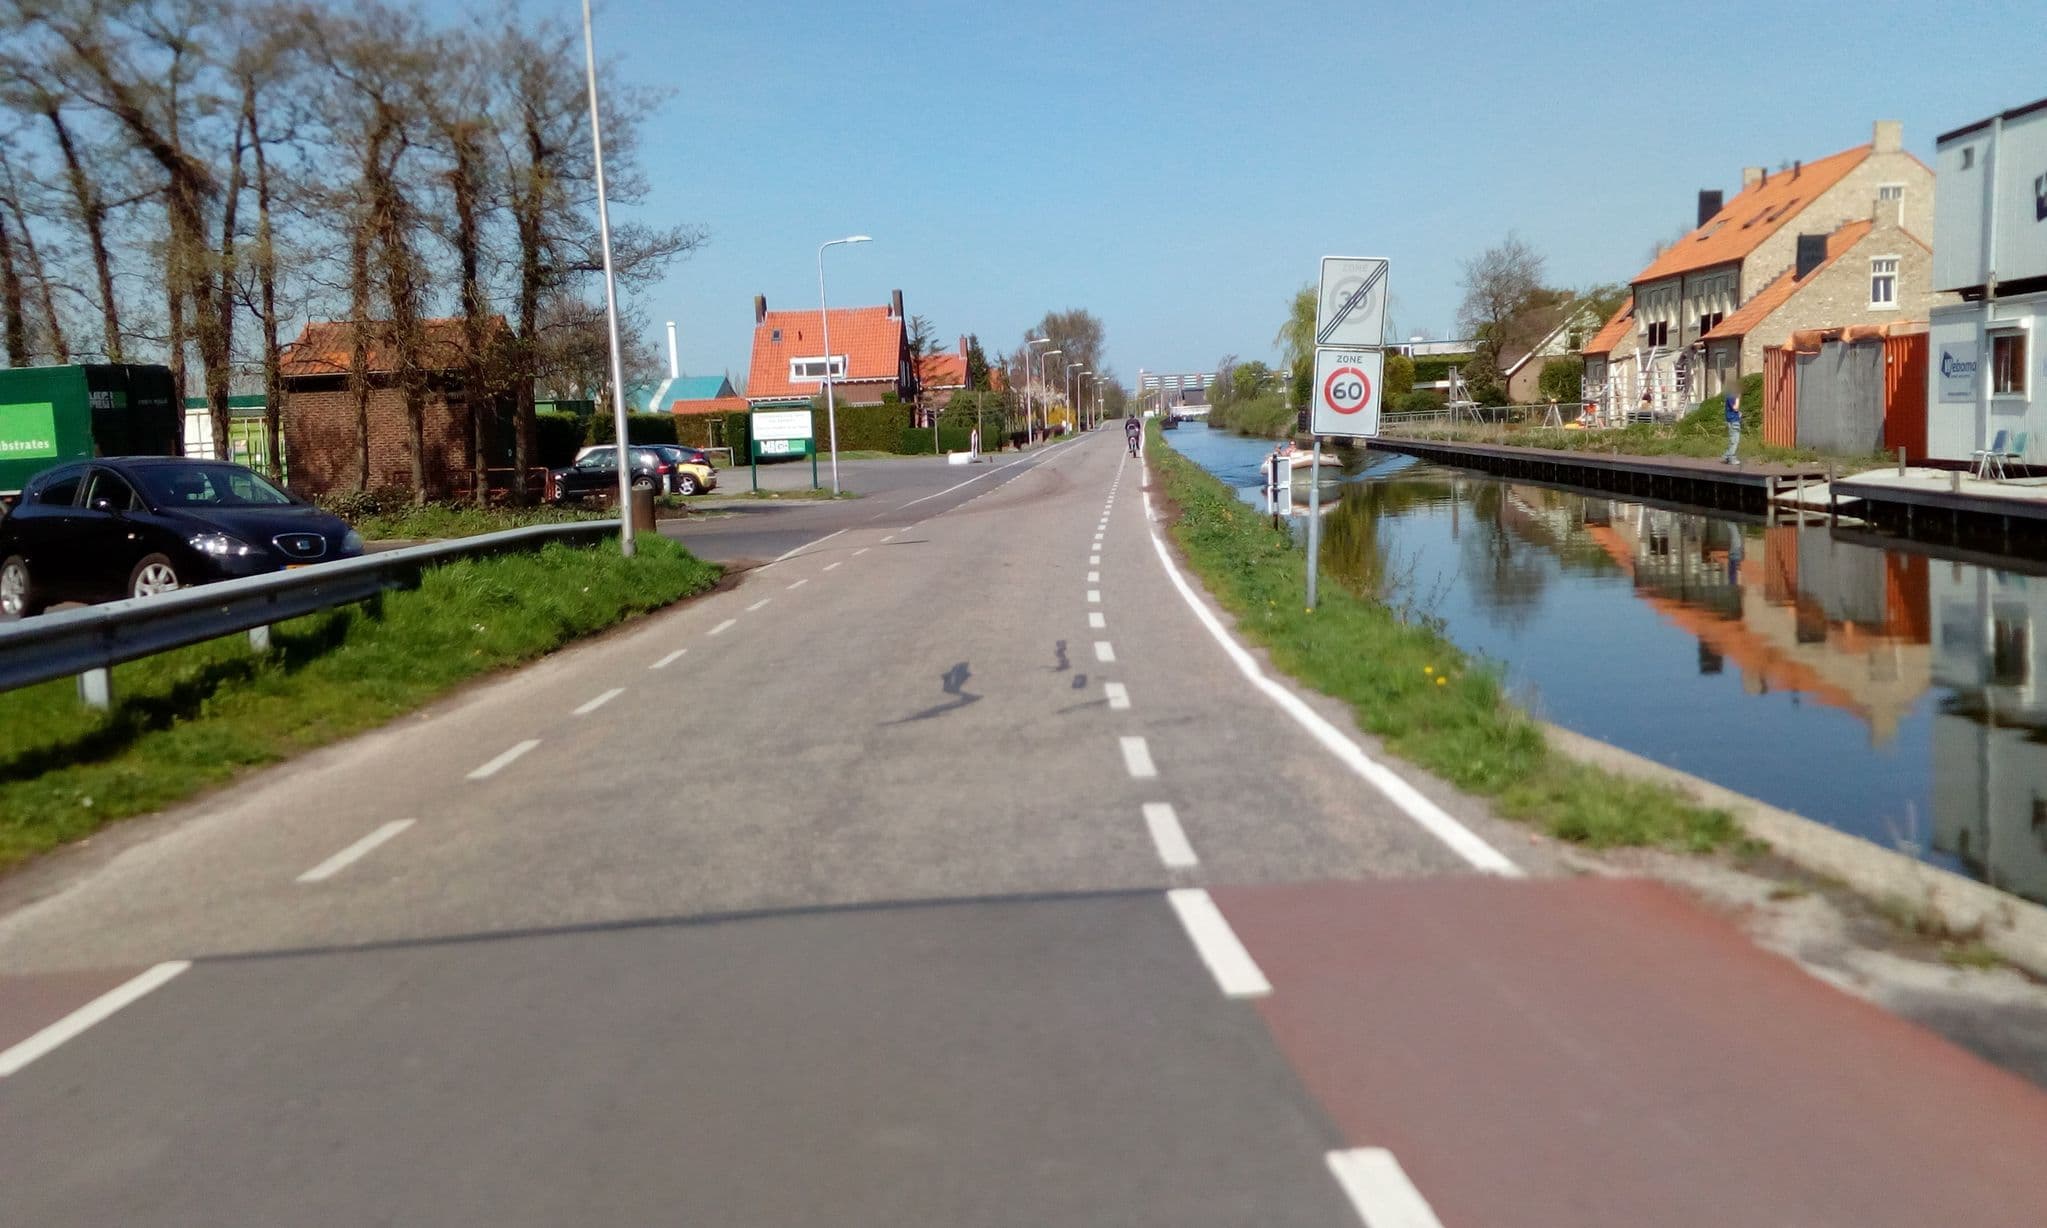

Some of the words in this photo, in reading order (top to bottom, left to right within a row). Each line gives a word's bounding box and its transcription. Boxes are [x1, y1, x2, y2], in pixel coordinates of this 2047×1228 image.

[1336, 355, 1363, 364] ZONE
[1333, 382, 1363, 400] 60
[0, 439, 50, 451] bstrates
